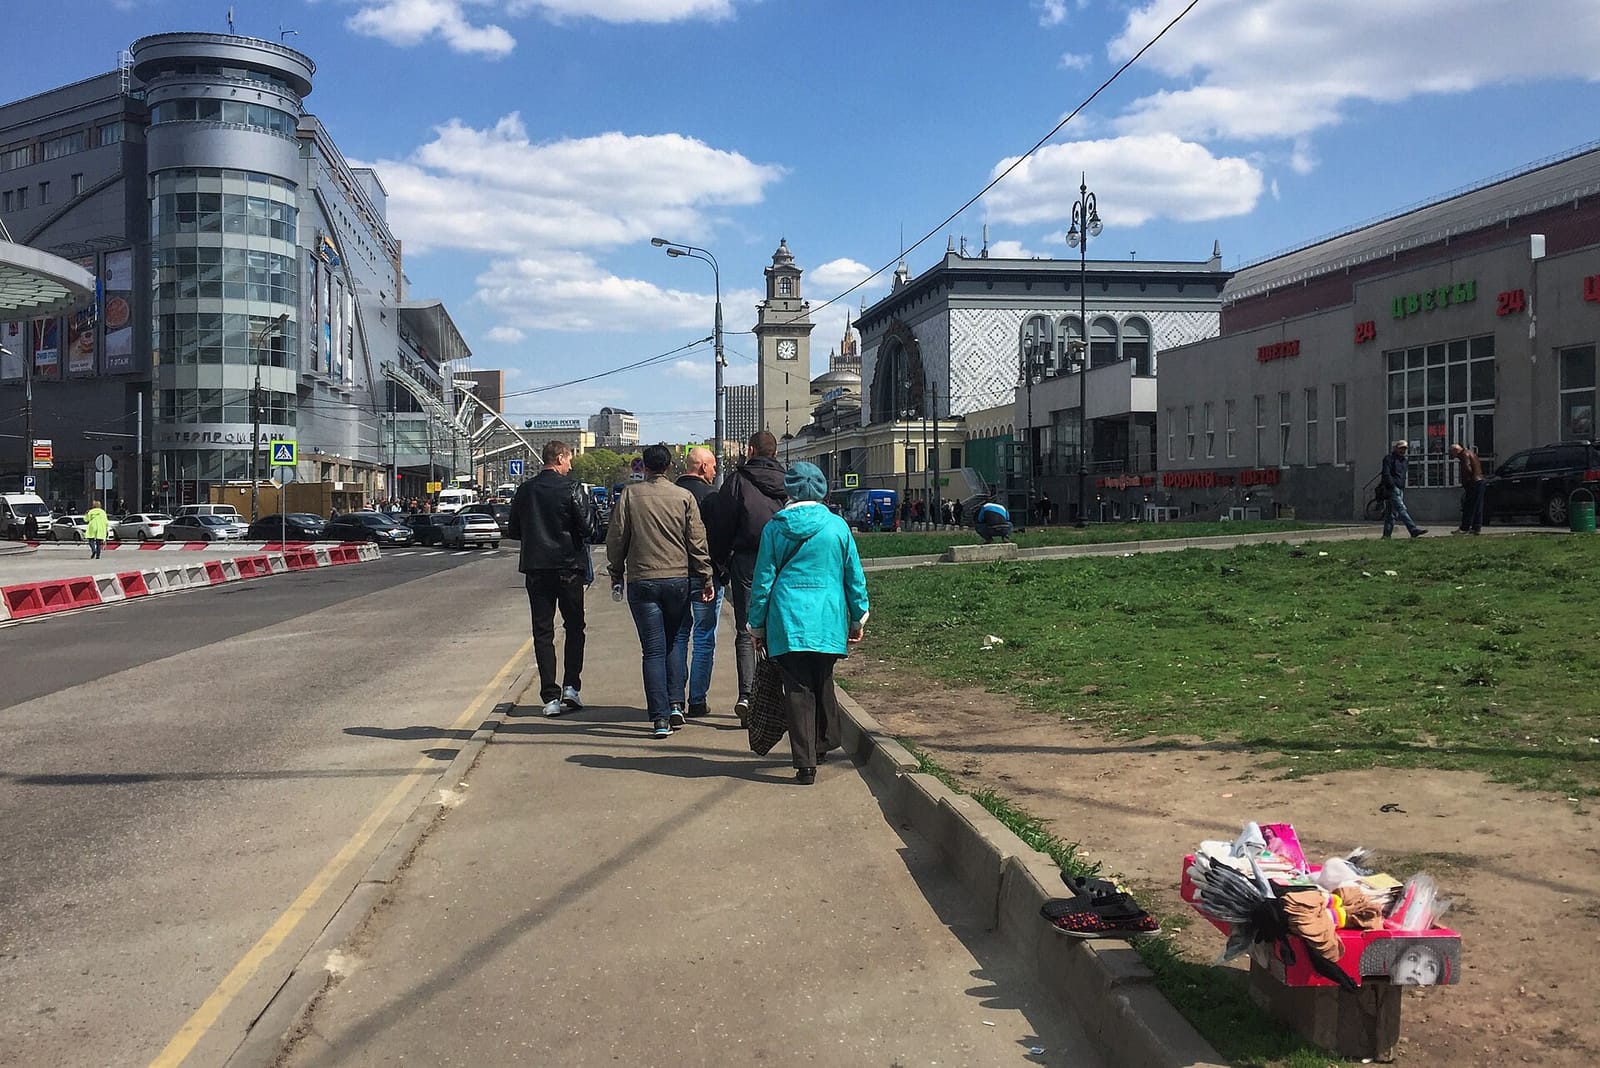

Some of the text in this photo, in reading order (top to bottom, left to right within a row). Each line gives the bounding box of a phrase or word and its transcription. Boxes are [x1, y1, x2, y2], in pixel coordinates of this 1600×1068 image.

[1390, 279, 1476, 320] ЦВЕТЫ
[1496, 288, 1528, 317] 24
[1354, 320, 1377, 345] 24
[1256, 339, 1300, 364] ЦВЕТЫ
[26, 477, 33, 486] P
[1163, 472, 1217, 488] ПРОДУКТЫ
